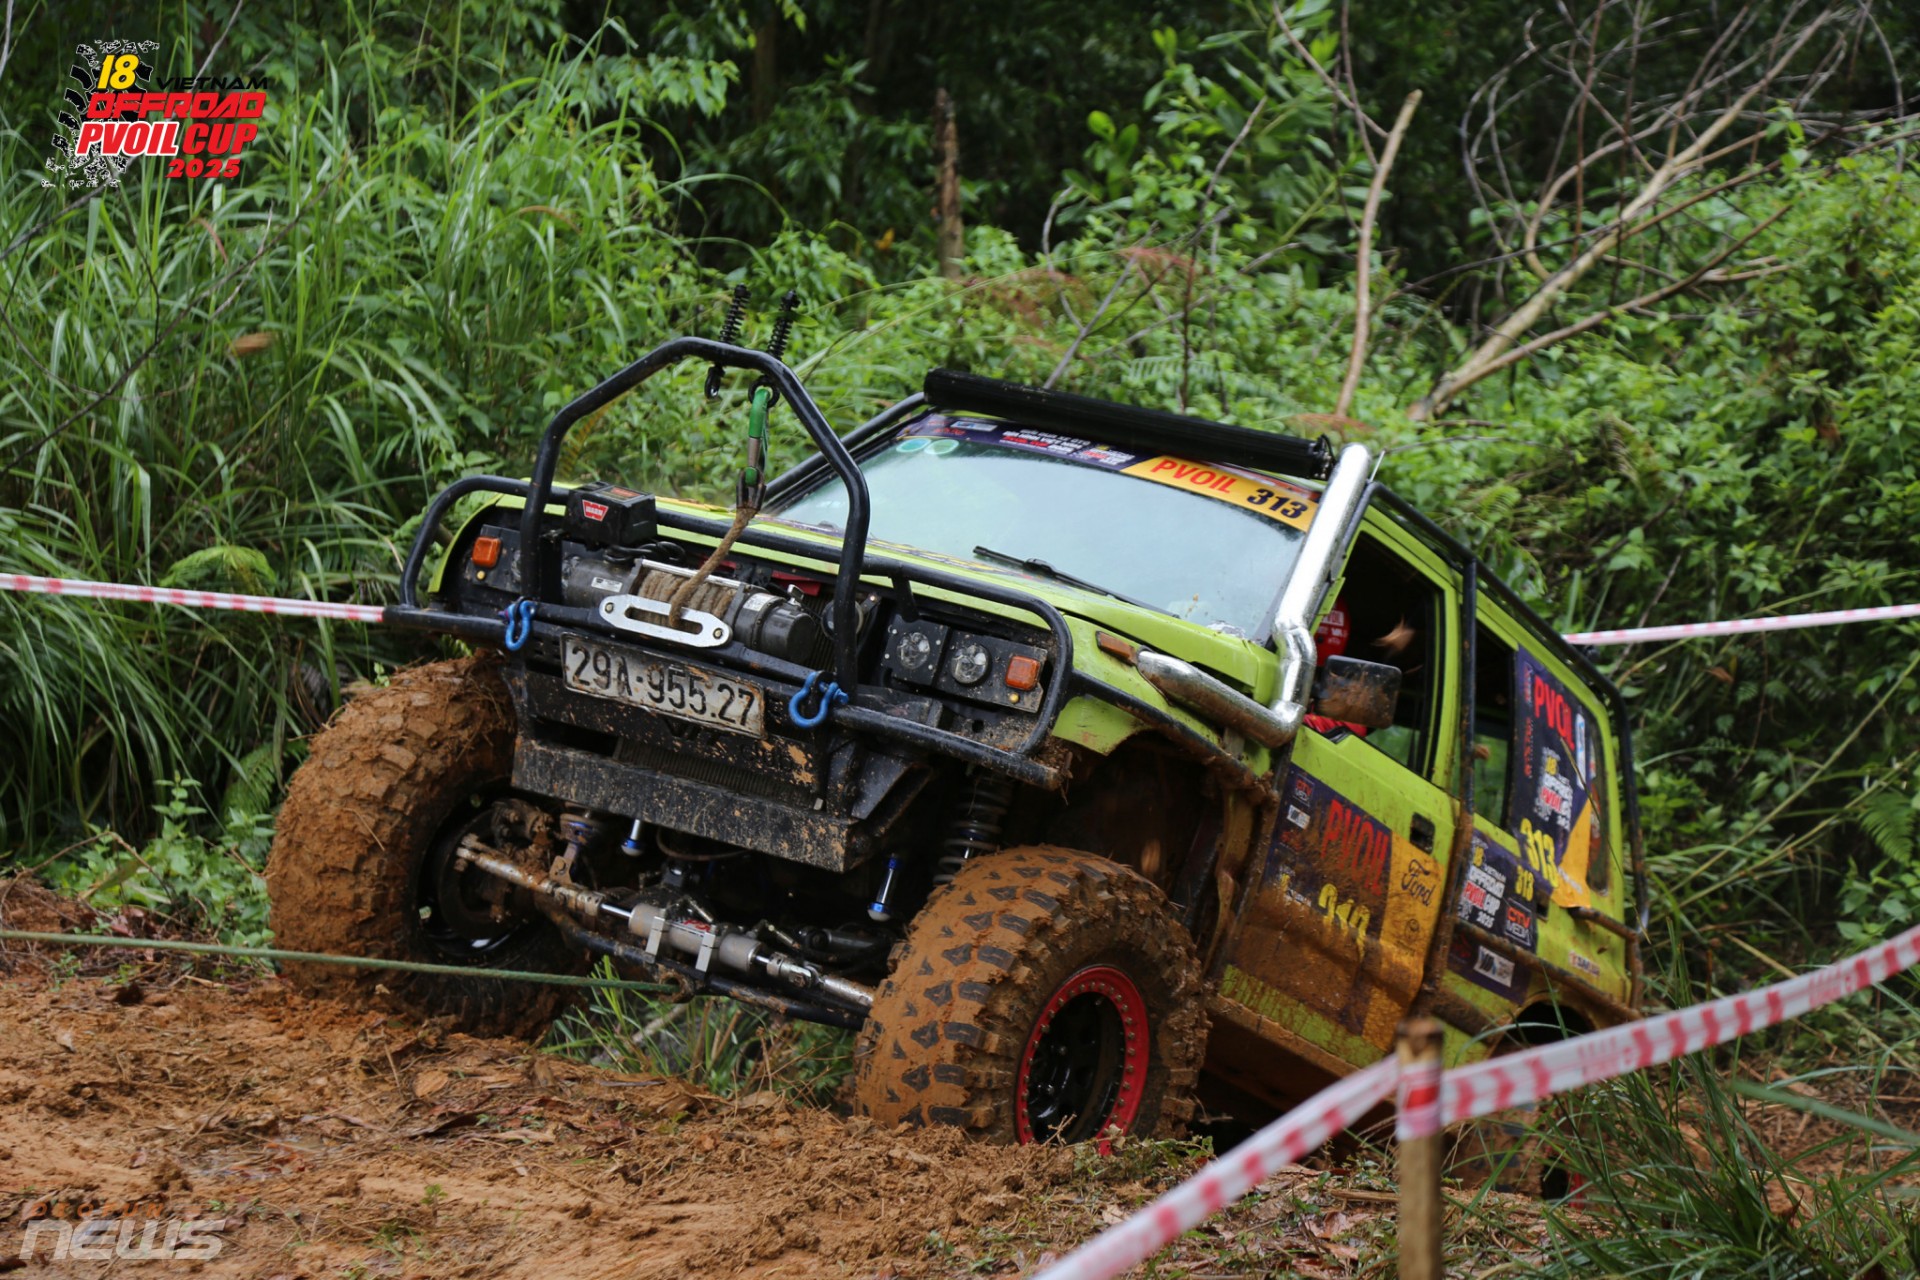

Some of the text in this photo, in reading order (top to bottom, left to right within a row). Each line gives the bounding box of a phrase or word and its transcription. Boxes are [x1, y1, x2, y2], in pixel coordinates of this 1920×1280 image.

[1151, 458, 1308, 519] PVOIL 313
[571, 645, 756, 727] 29A-955.27
[1320, 799, 1390, 897] PVOIL
[1520, 818, 1559, 888] 313
[1401, 859, 1436, 907] Ford
[1515, 864, 1535, 902] 313
[1506, 919, 1530, 939] MEDIA
[1507, 906, 1531, 929] CTV
